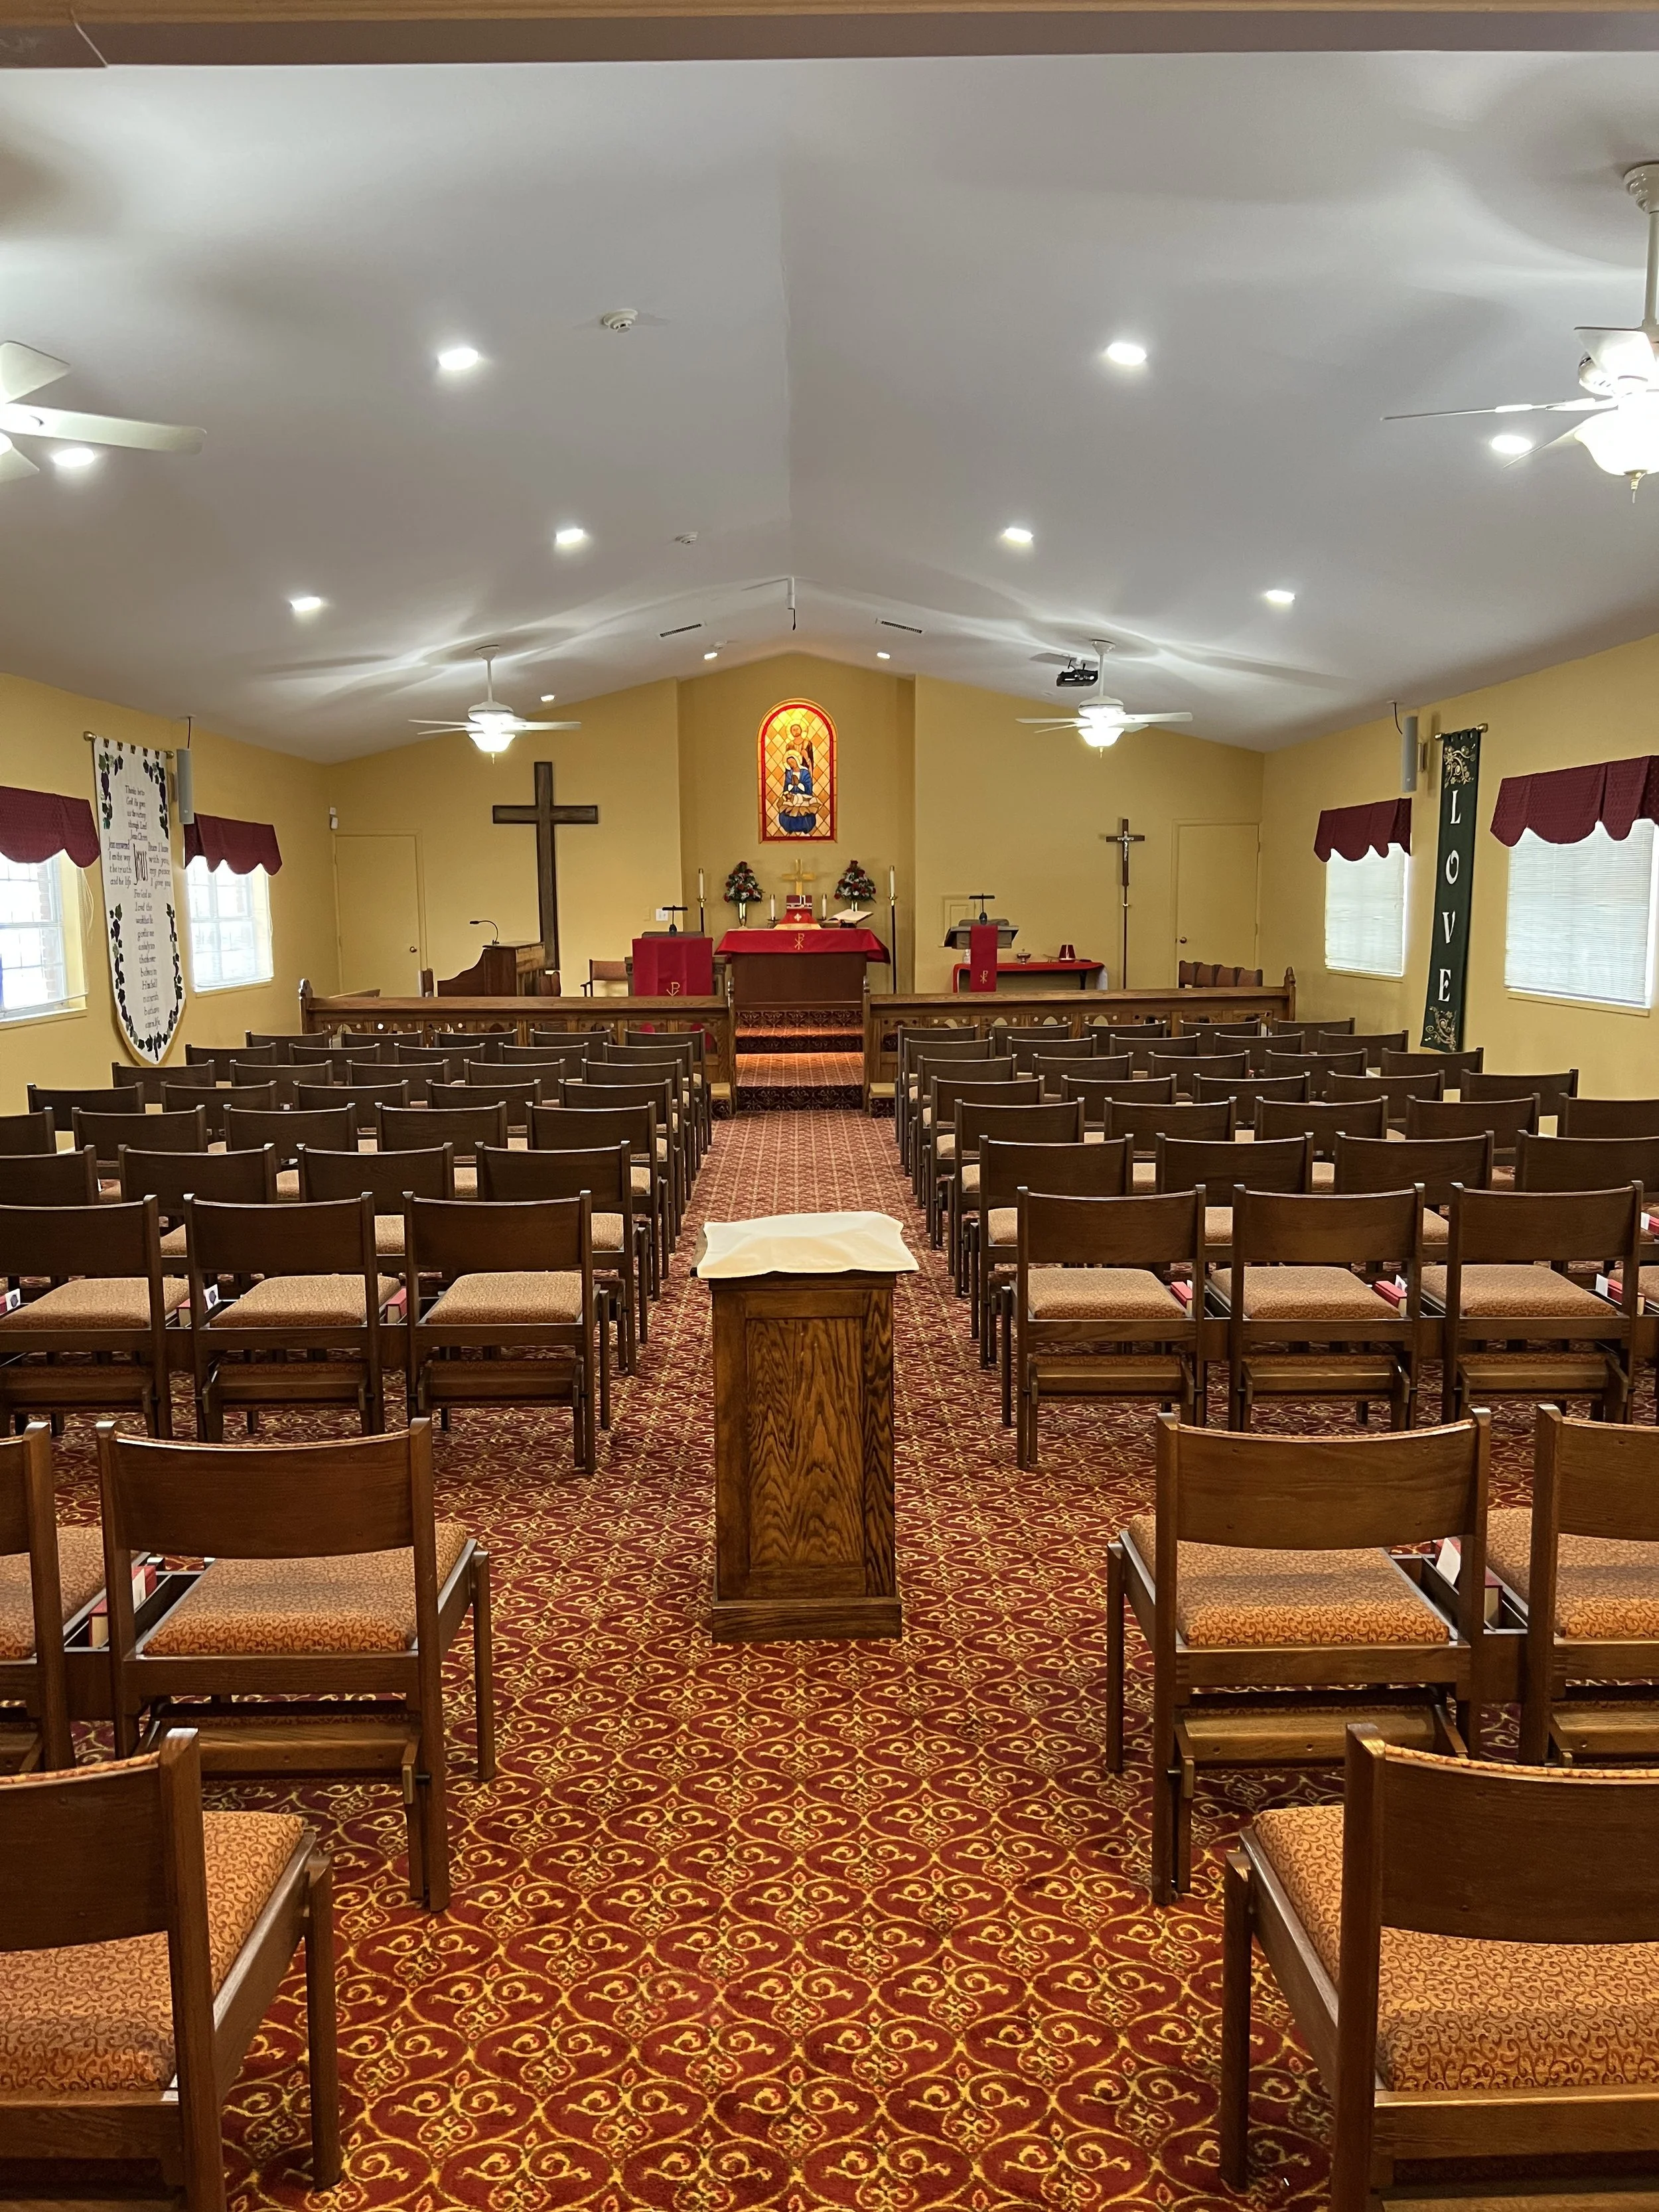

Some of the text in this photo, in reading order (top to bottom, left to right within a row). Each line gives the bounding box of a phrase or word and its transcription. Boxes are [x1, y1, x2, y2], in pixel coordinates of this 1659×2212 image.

[148, 841, 157, 851] Peace
[149, 854, 160, 863] with
[118, 865, 132, 874] truth
[158, 869, 170, 877] peace
[155, 881, 164, 890] give
[1438, 790, 1461, 1002] LOVE
